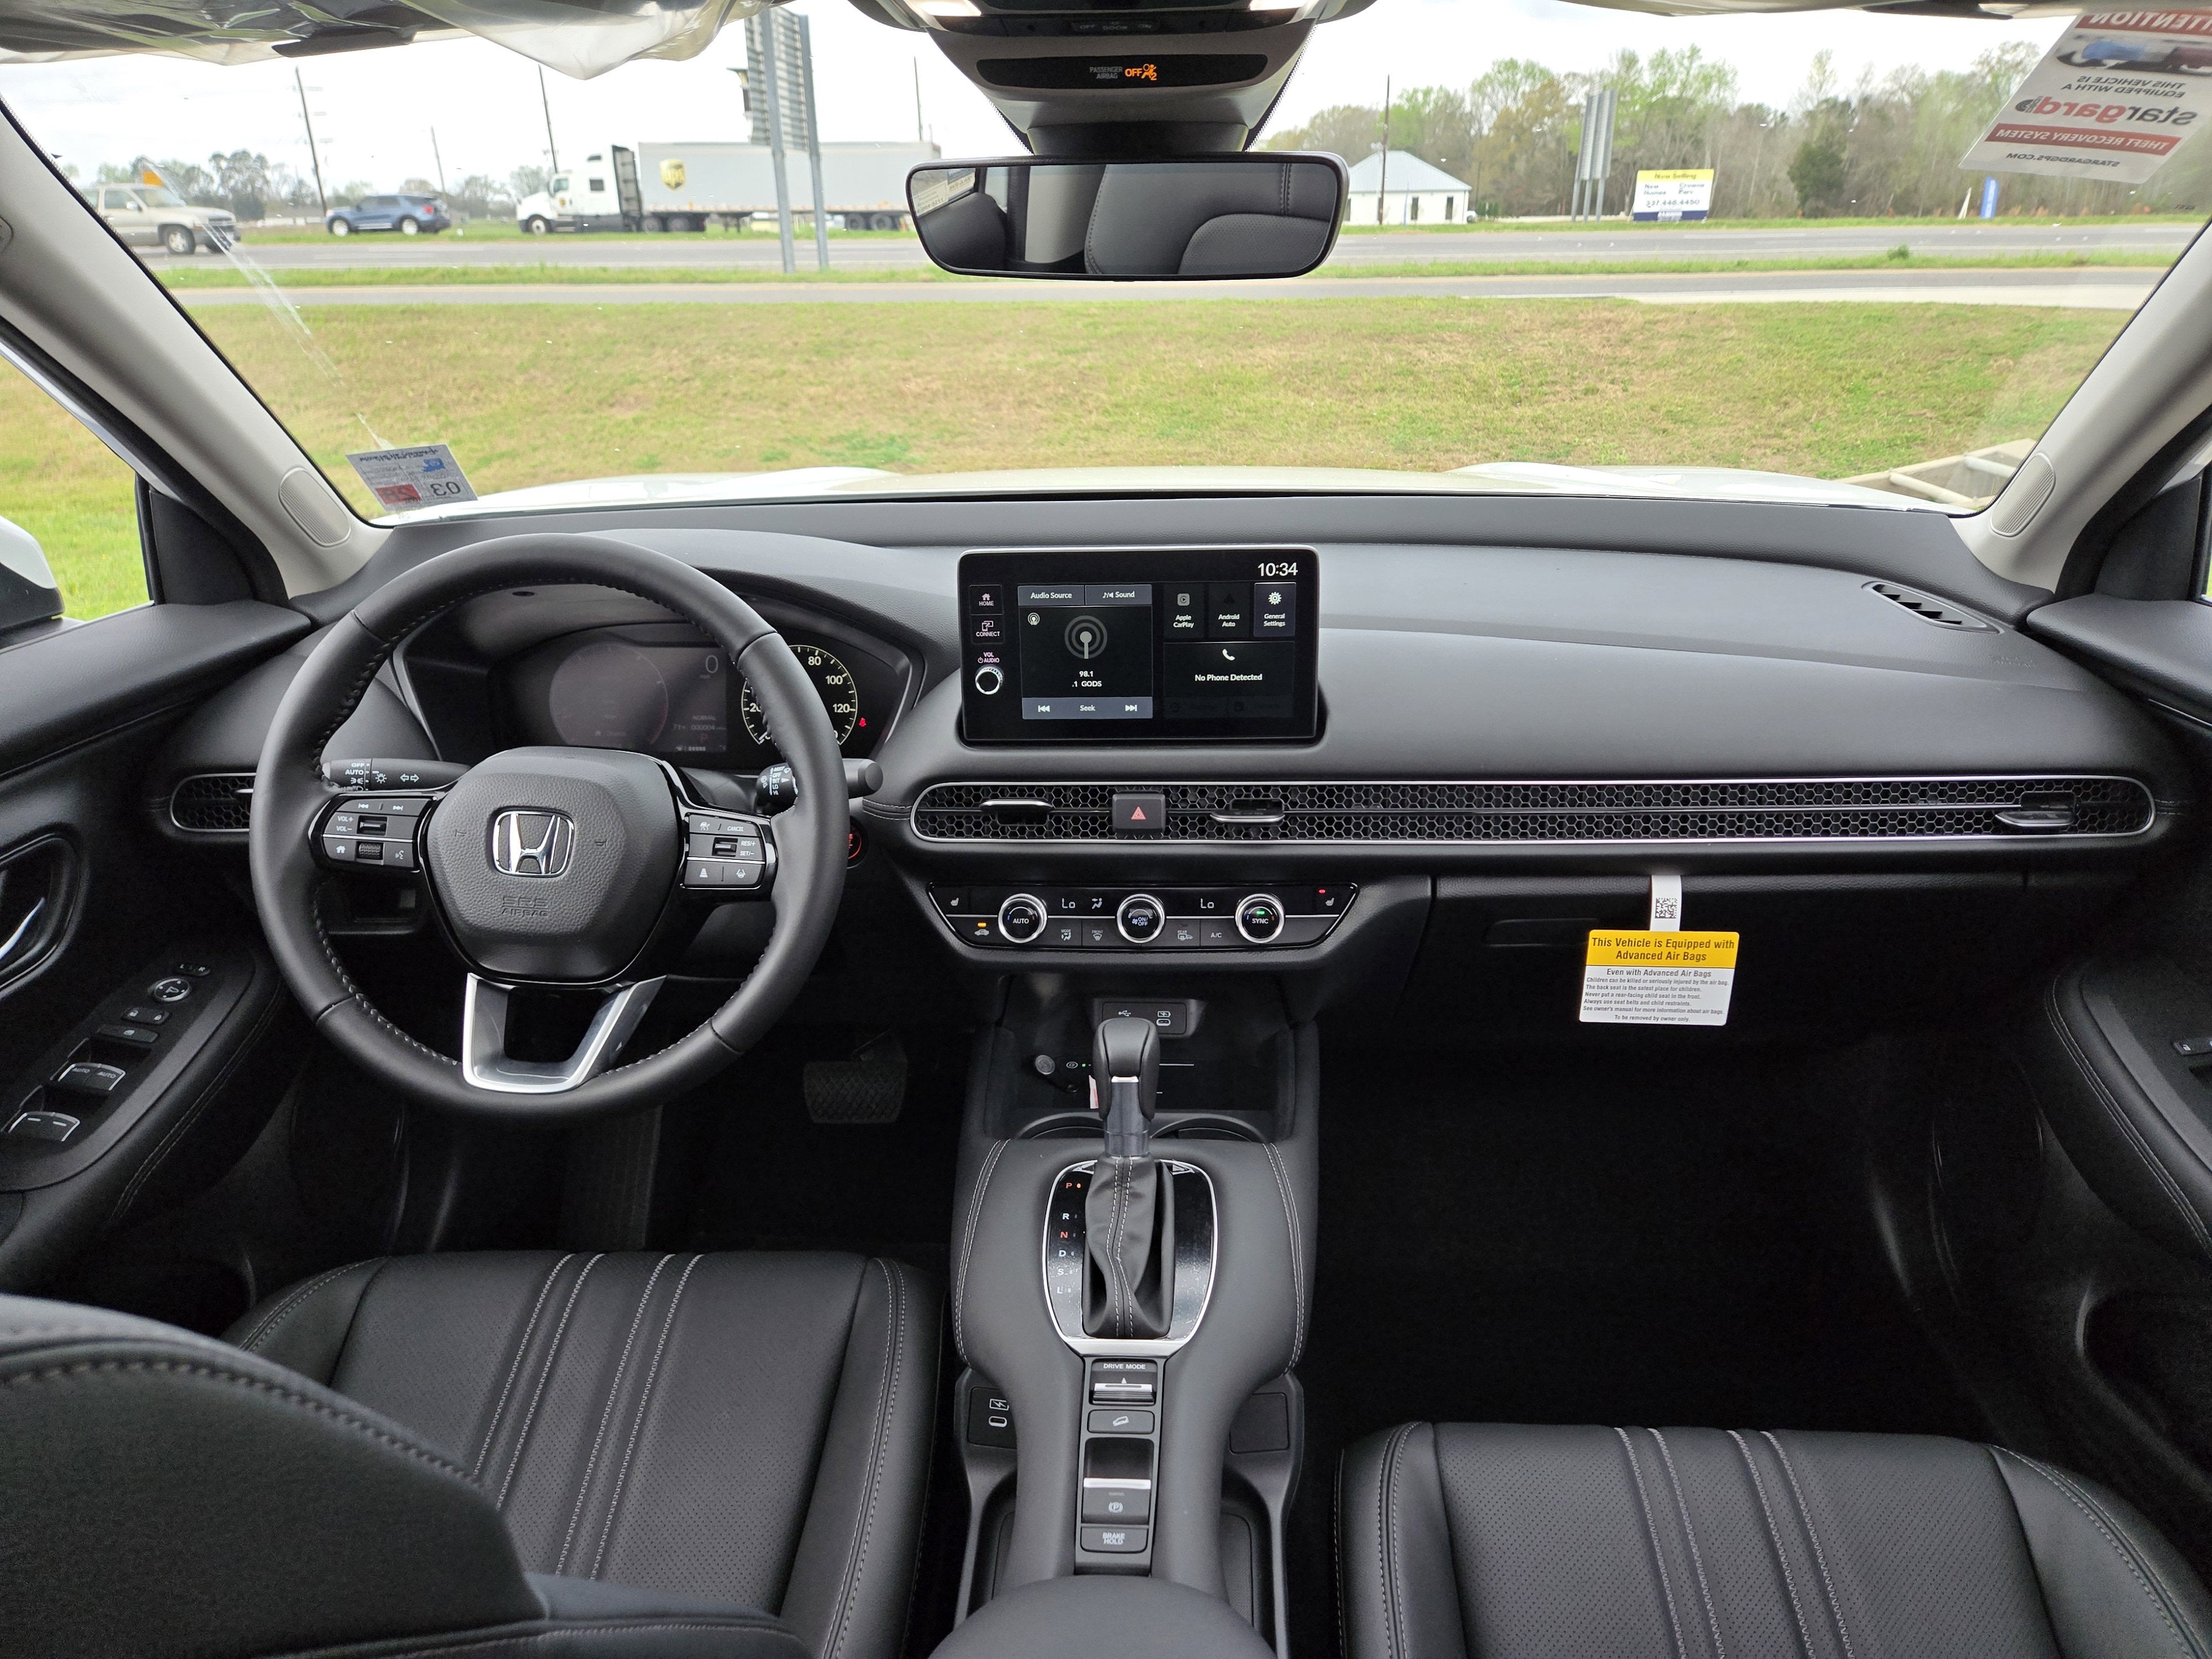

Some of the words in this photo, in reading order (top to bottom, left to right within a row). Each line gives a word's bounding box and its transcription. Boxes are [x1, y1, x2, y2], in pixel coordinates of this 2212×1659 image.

[1125, 68, 1142, 77] OFF
[1258, 563, 1298, 576] 10:34
[705, 655, 718, 674] 0
[808, 656, 821, 666] 80
[826, 675, 843, 685] 100
[833, 703, 850, 713] 120
[502, 896, 549, 906] SRS
[1062, 898, 1076, 909] Lo
[1201, 898, 1214, 909] Lo
[501, 907, 549, 917] AIRBAG
[1592, 937, 1612, 946] This
[1616, 938, 1651, 947] Vehicle
[1654, 939, 1663, 947] is
[1666, 939, 1711, 950] Equipped
[1714, 940, 1734, 948] with
[1616, 951, 1663, 960] Advanced
[1666, 952, 1680, 960] Air
[1683, 952, 1707, 962] Bags
[98, 1071, 117, 1079] AUTO
